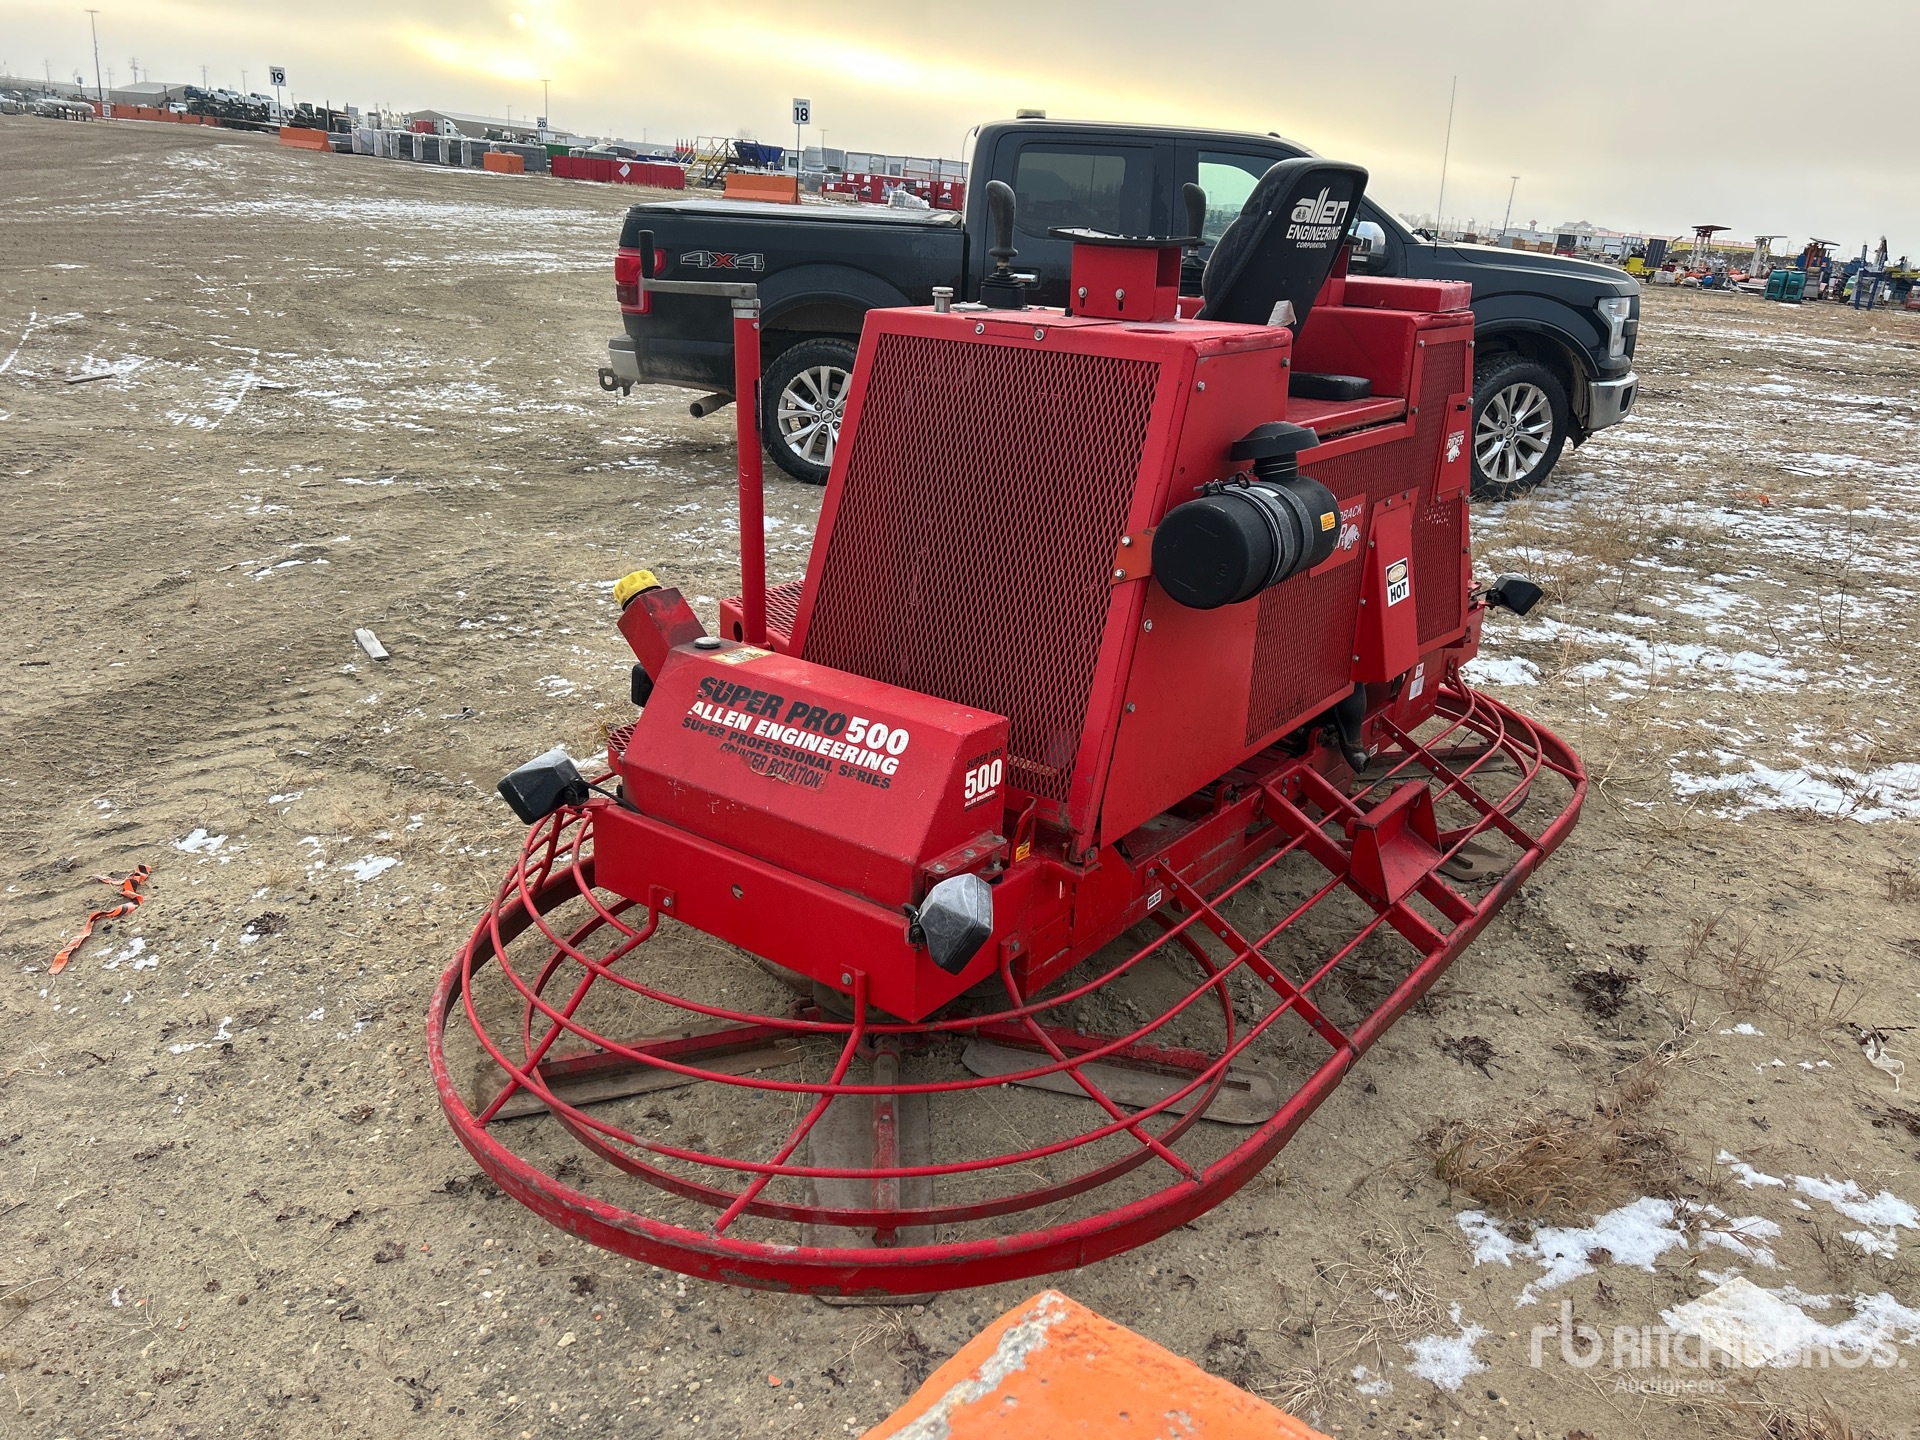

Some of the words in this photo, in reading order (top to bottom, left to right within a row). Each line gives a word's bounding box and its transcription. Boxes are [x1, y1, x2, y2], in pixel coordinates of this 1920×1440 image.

[271, 72, 284, 83] 19
[537, 120, 547, 128] 20
[795, 107, 808, 121] 18
[1286, 224, 1342, 240] ENGINEERING
[1296, 241, 1327, 249] CORPORATION
[1390, 581, 1406, 603] HOT
[697, 676, 785, 719] SUPER
[784, 701, 847, 736] PRO
[845, 716, 910, 755] 500
[687, 701, 753, 731] ALLEN
[753, 719, 900, 775] ENGINEERING
[682, 717, 726, 739] SUPER
[728, 731, 833, 772] PROFESSIONAL
[838, 764, 892, 790] SERIES
[966, 753, 988, 769] SUPER
[990, 747, 1003, 759] PRO
[767, 758, 824, 788] ROTATION
[964, 759, 1002, 799] 500
